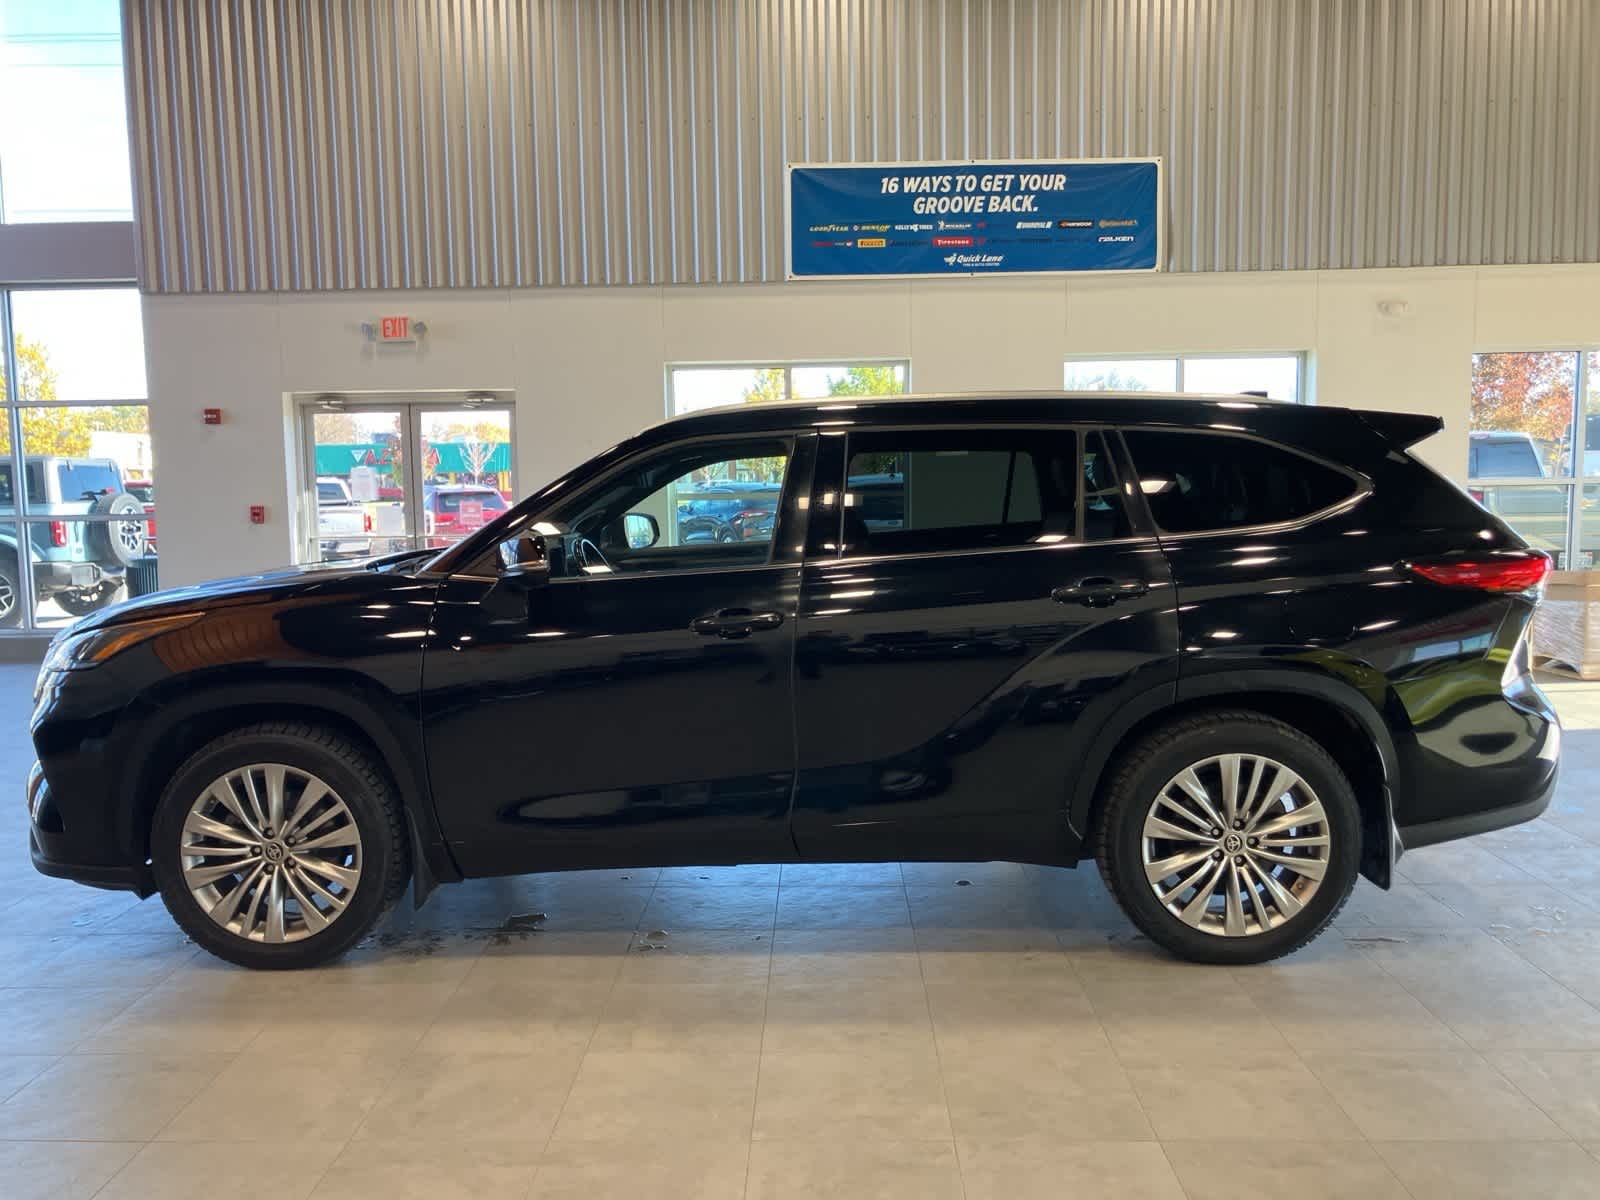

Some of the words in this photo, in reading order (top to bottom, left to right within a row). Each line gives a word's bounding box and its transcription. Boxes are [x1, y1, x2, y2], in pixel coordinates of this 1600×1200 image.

[881, 177, 899, 194] 16
[903, 175, 952, 194] WAYS
[955, 175, 978, 193] TO
[980, 174, 1015, 192] GET
[1018, 174, 1067, 191] YOUR
[913, 196, 985, 214] GROOVE
[987, 194, 1039, 213] BACK.
[957, 254, 981, 264] Quick
[981, 254, 1004, 263] Lane
[382, 316, 409, 337] EXIT
